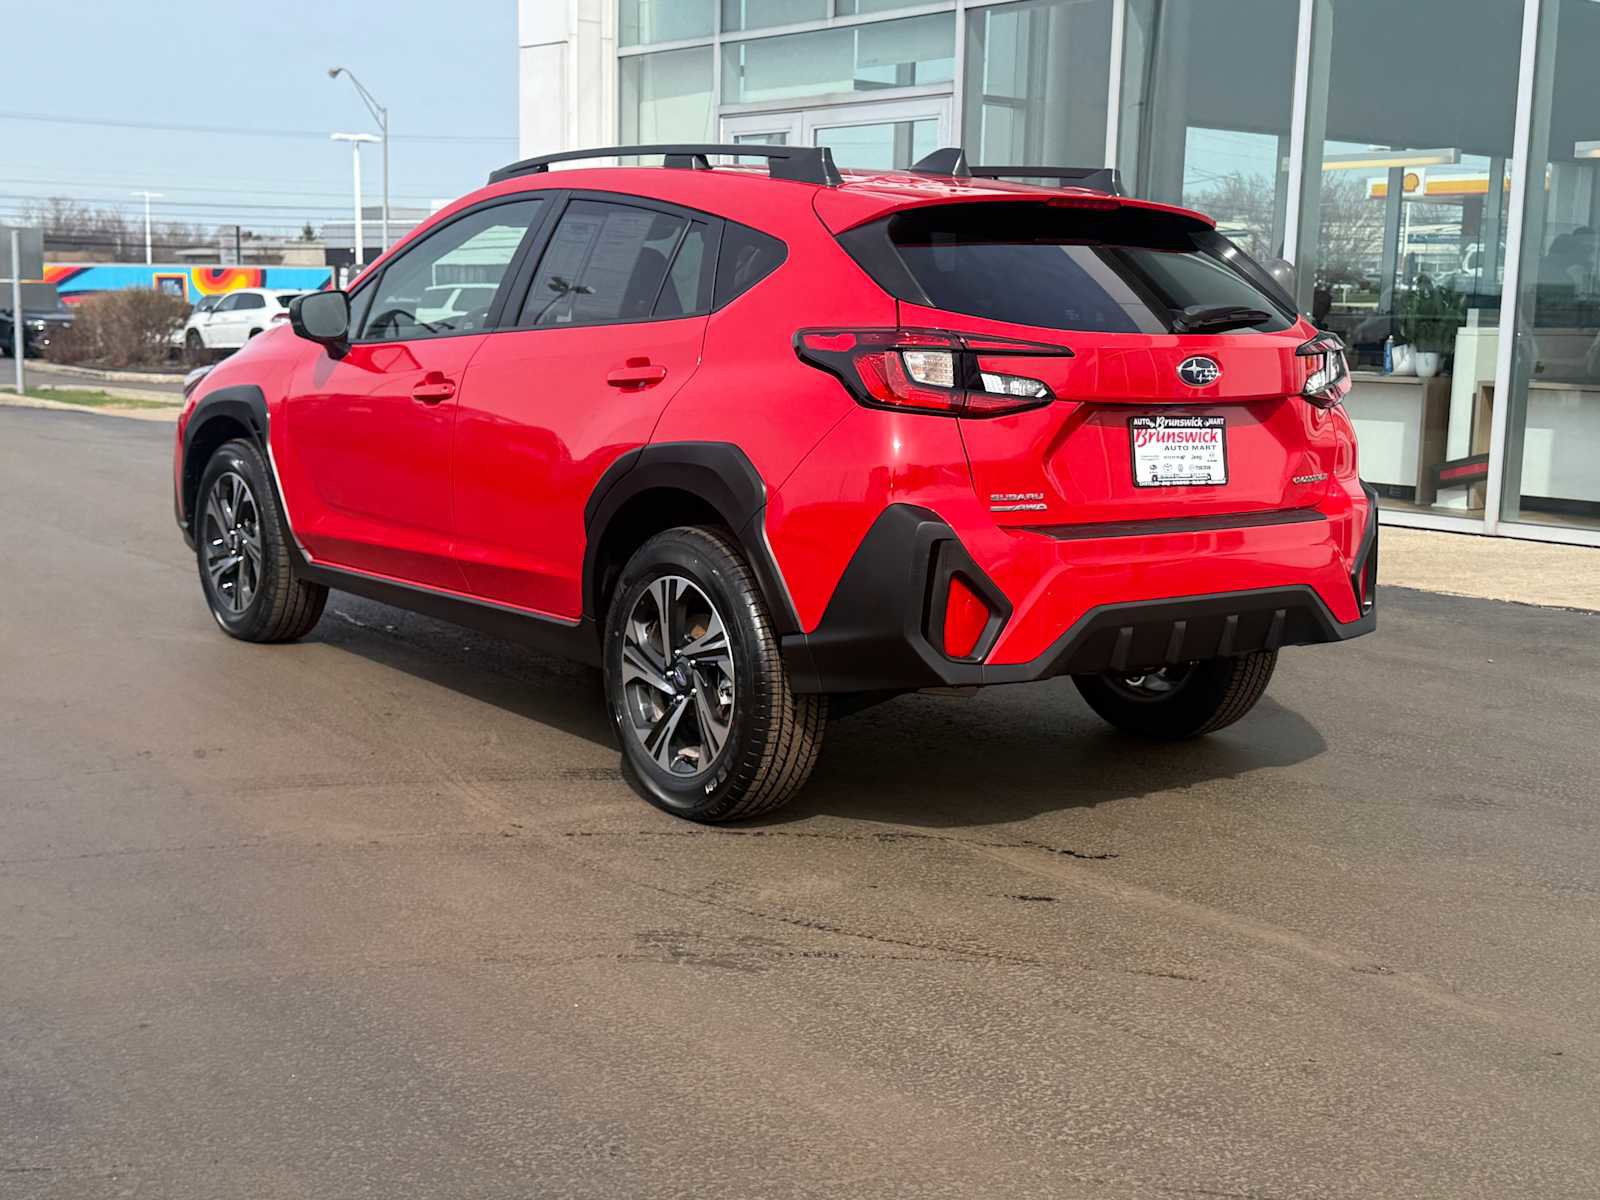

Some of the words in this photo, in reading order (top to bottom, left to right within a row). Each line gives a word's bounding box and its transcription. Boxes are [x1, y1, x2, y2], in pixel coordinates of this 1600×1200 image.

[1133, 418, 1150, 426] AUTO
[1156, 416, 1203, 430] Brunswick
[1135, 428, 1218, 448] Brunswick
[990, 493, 1044, 501] SUBARU
